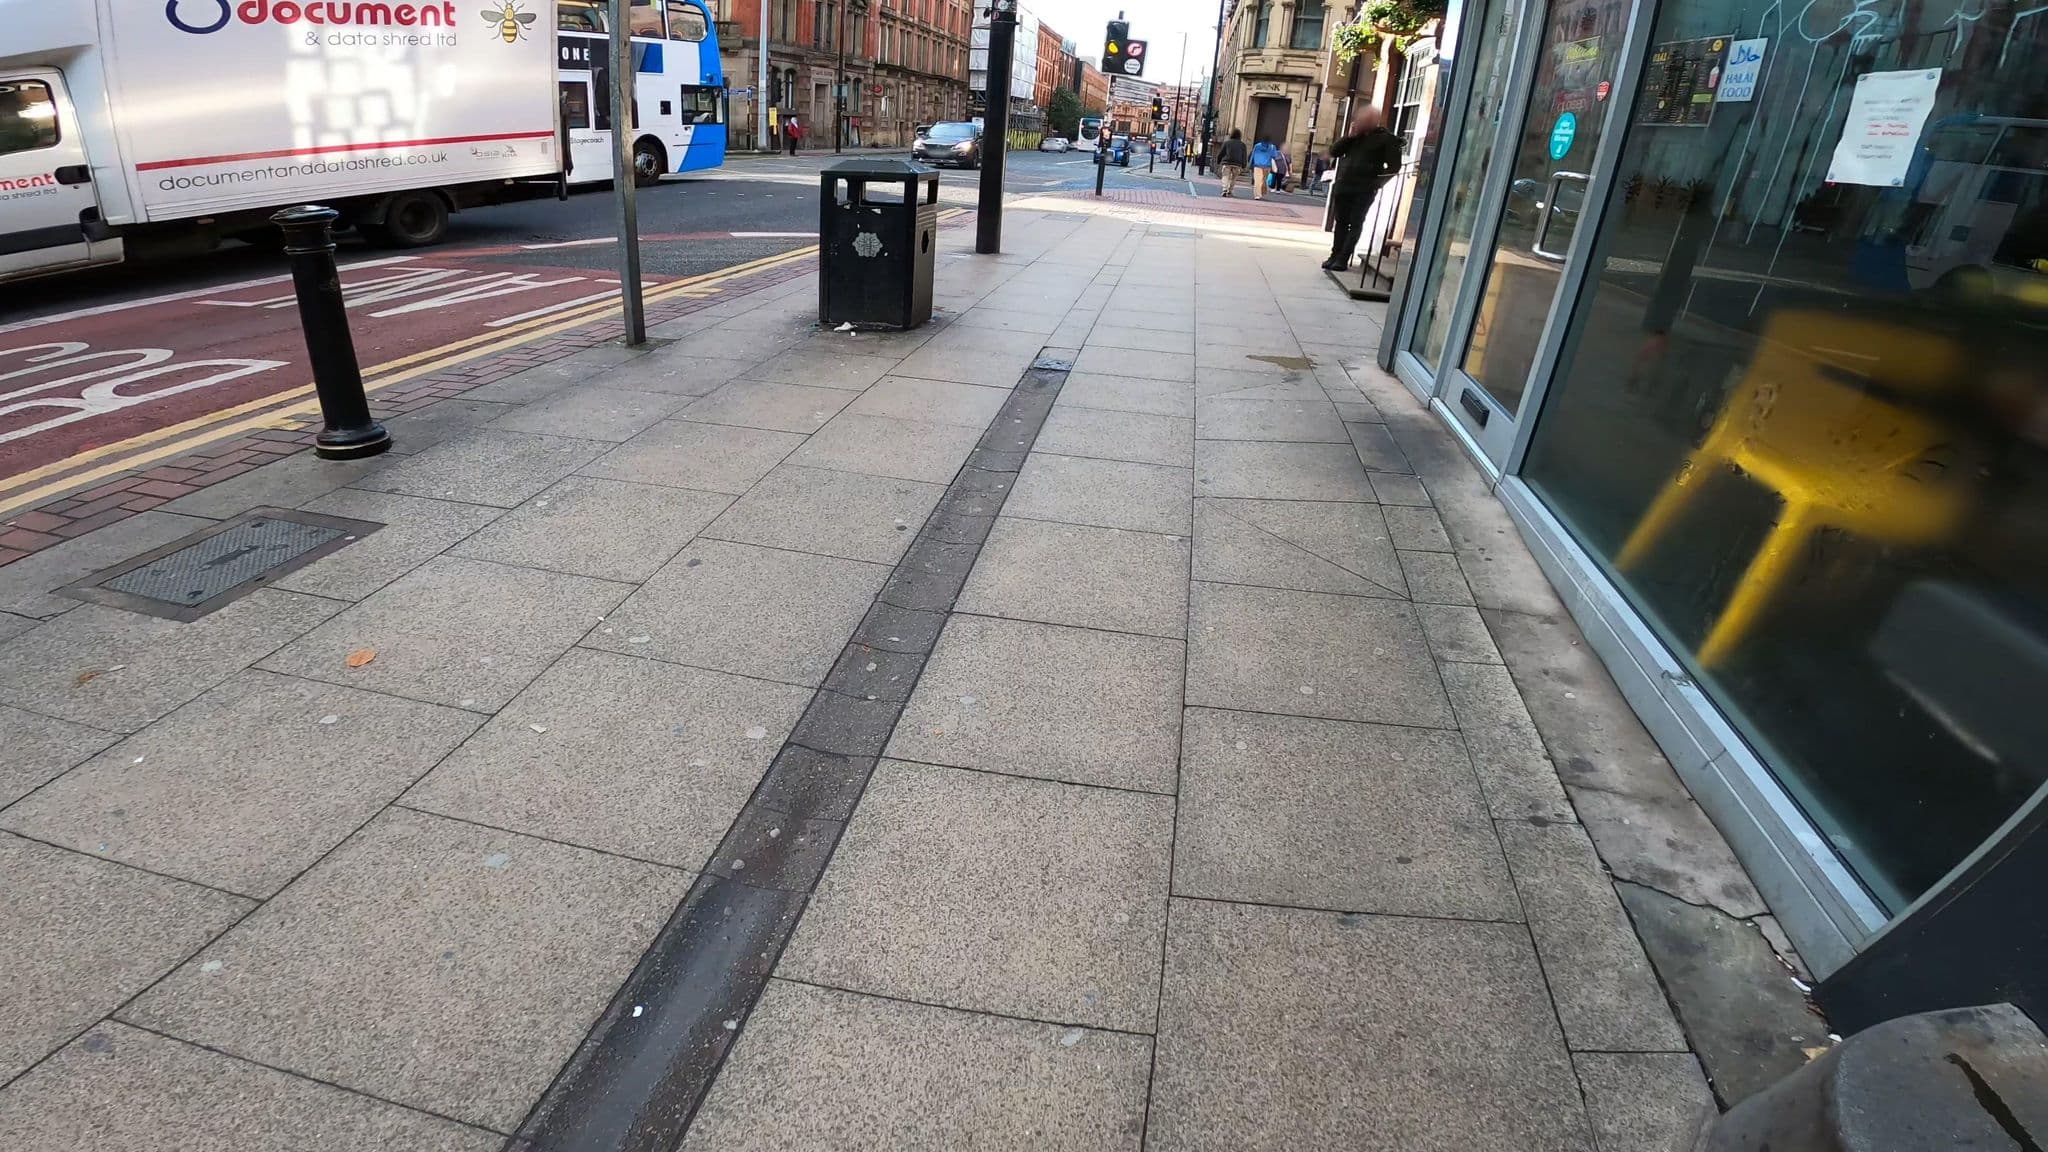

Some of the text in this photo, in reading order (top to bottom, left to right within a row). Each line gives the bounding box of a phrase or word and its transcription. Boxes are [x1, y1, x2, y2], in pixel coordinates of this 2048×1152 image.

[237, 0, 456, 26] document
[305, 31, 457, 46] & data shred ltd
[1725, 72, 1754, 84] HALAL
[1721, 87, 1751, 97] FOOD
[159, 151, 449, 191] documentanddatashred.co.uk
